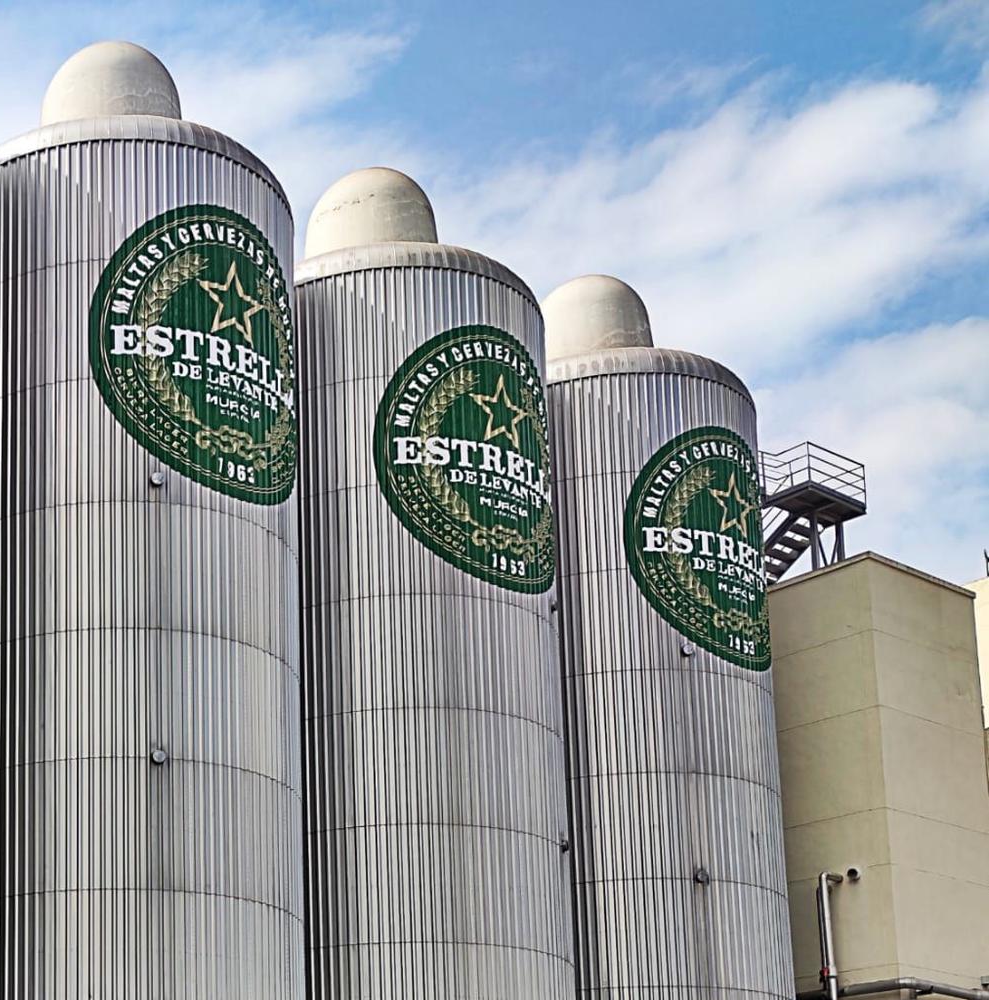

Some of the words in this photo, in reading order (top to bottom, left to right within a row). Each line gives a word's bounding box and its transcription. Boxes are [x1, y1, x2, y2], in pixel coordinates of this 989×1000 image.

[111, 243, 164, 315] MALTAS
[160, 231, 177, 250] Y
[178, 222, 264, 266] CERVEZAS
[172, 361, 202, 380] DE
[394, 362, 440, 428] MALTAS
[436, 352, 451, 368] Y
[451, 341, 527, 376] CERVEZAS
[218, 457, 255, 484] 1963
[449, 469, 477, 484] DE
[479, 472, 541, 509] LEVANTE
[643, 460, 682, 518] MALTAS
[679, 450, 691, 465] Y
[693, 557, 716, 572] DE
